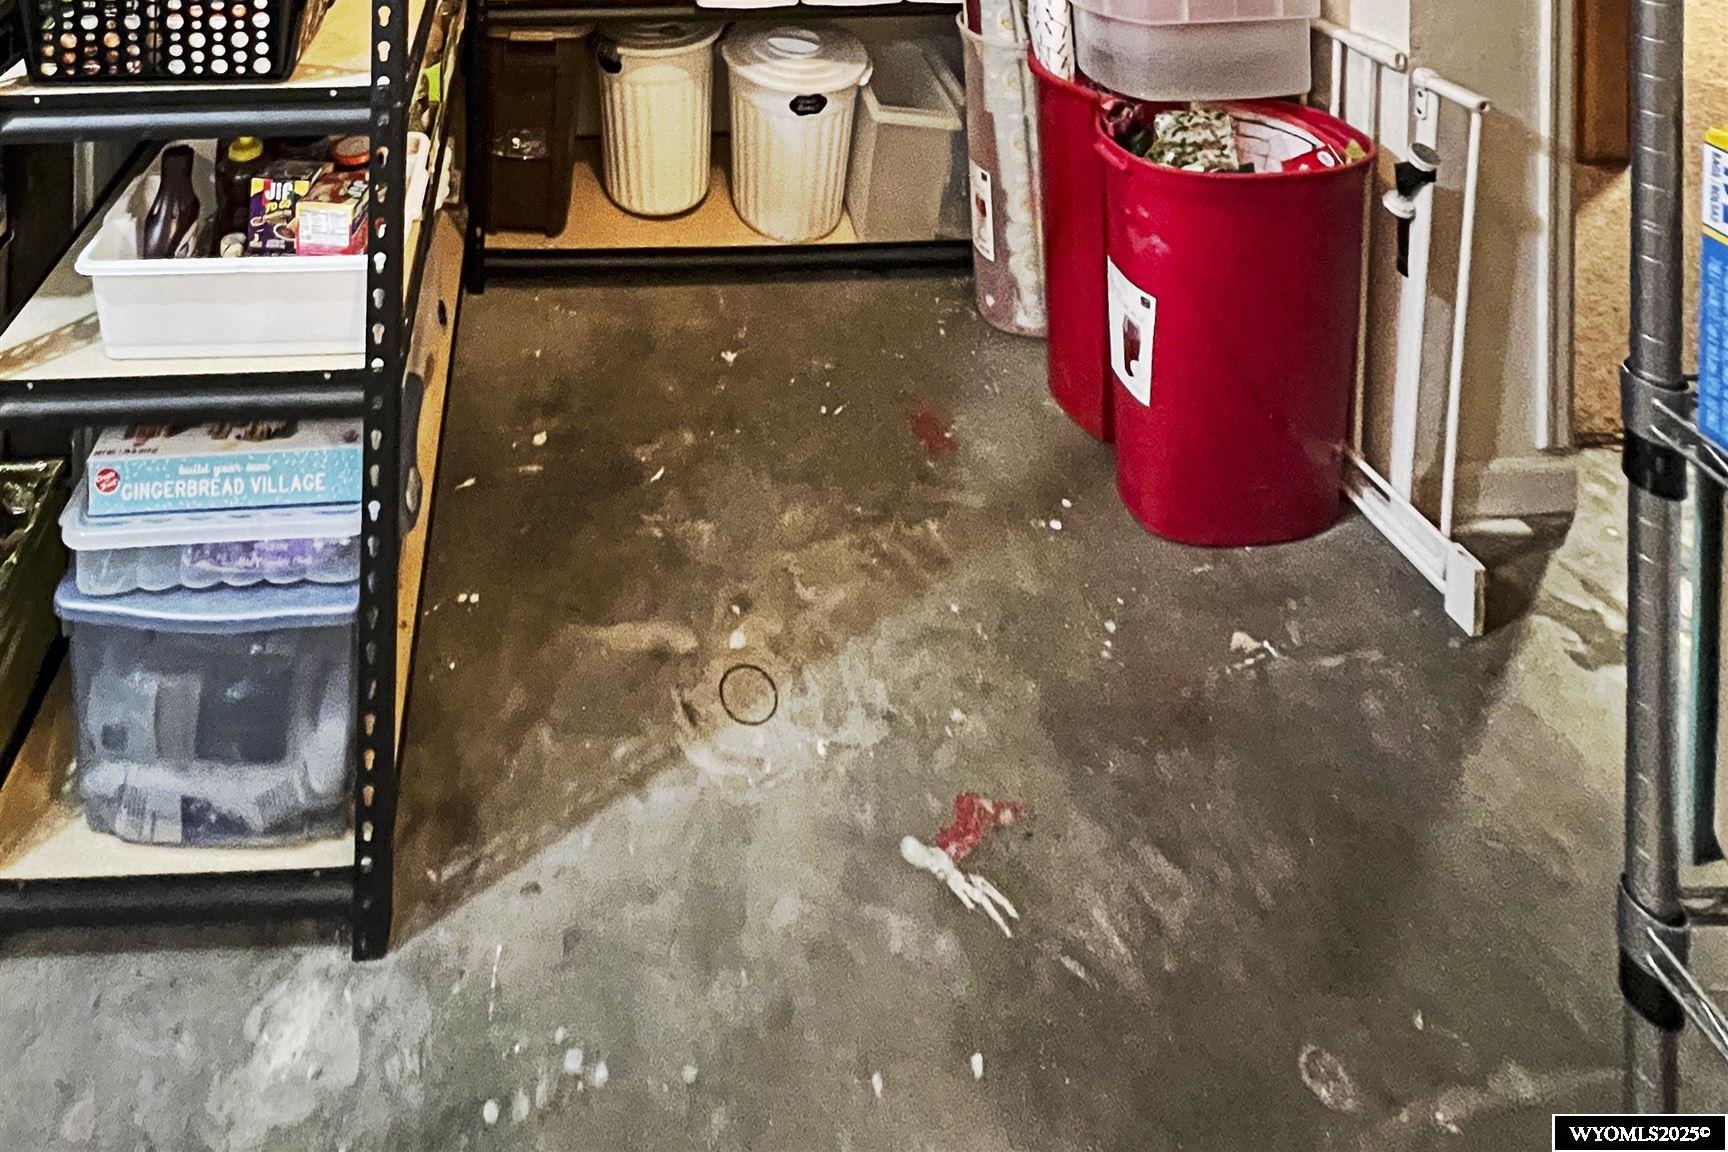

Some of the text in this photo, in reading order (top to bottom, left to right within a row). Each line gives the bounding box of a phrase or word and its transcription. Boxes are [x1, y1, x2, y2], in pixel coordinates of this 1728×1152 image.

[265, 182, 294, 201] JIF
[122, 478, 244, 501] GINGERBREAD
[250, 472, 326, 495] VILLAGE
